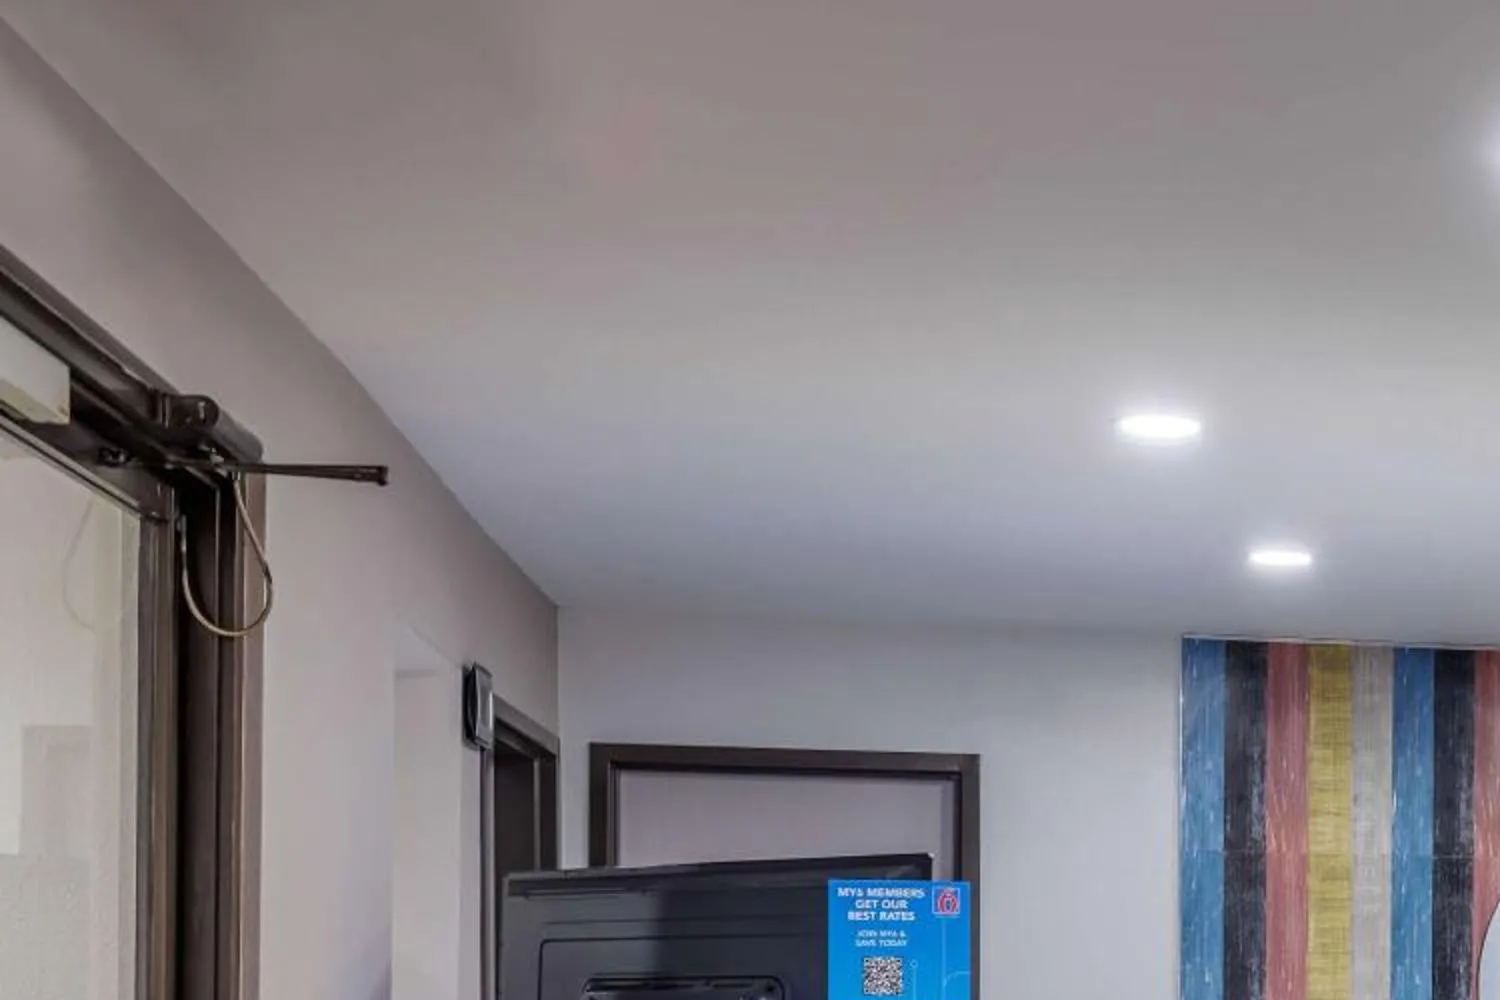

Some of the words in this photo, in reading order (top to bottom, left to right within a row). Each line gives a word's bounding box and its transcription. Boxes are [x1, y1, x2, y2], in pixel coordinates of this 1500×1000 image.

[867, 888, 925, 898] MEMBERS
[855, 899, 877, 909] GET
[881, 899, 908, 909] OUR
[847, 911, 876, 921] BEST
[879, 911, 915, 921] RATES
[879, 938, 908, 947] TODAY
